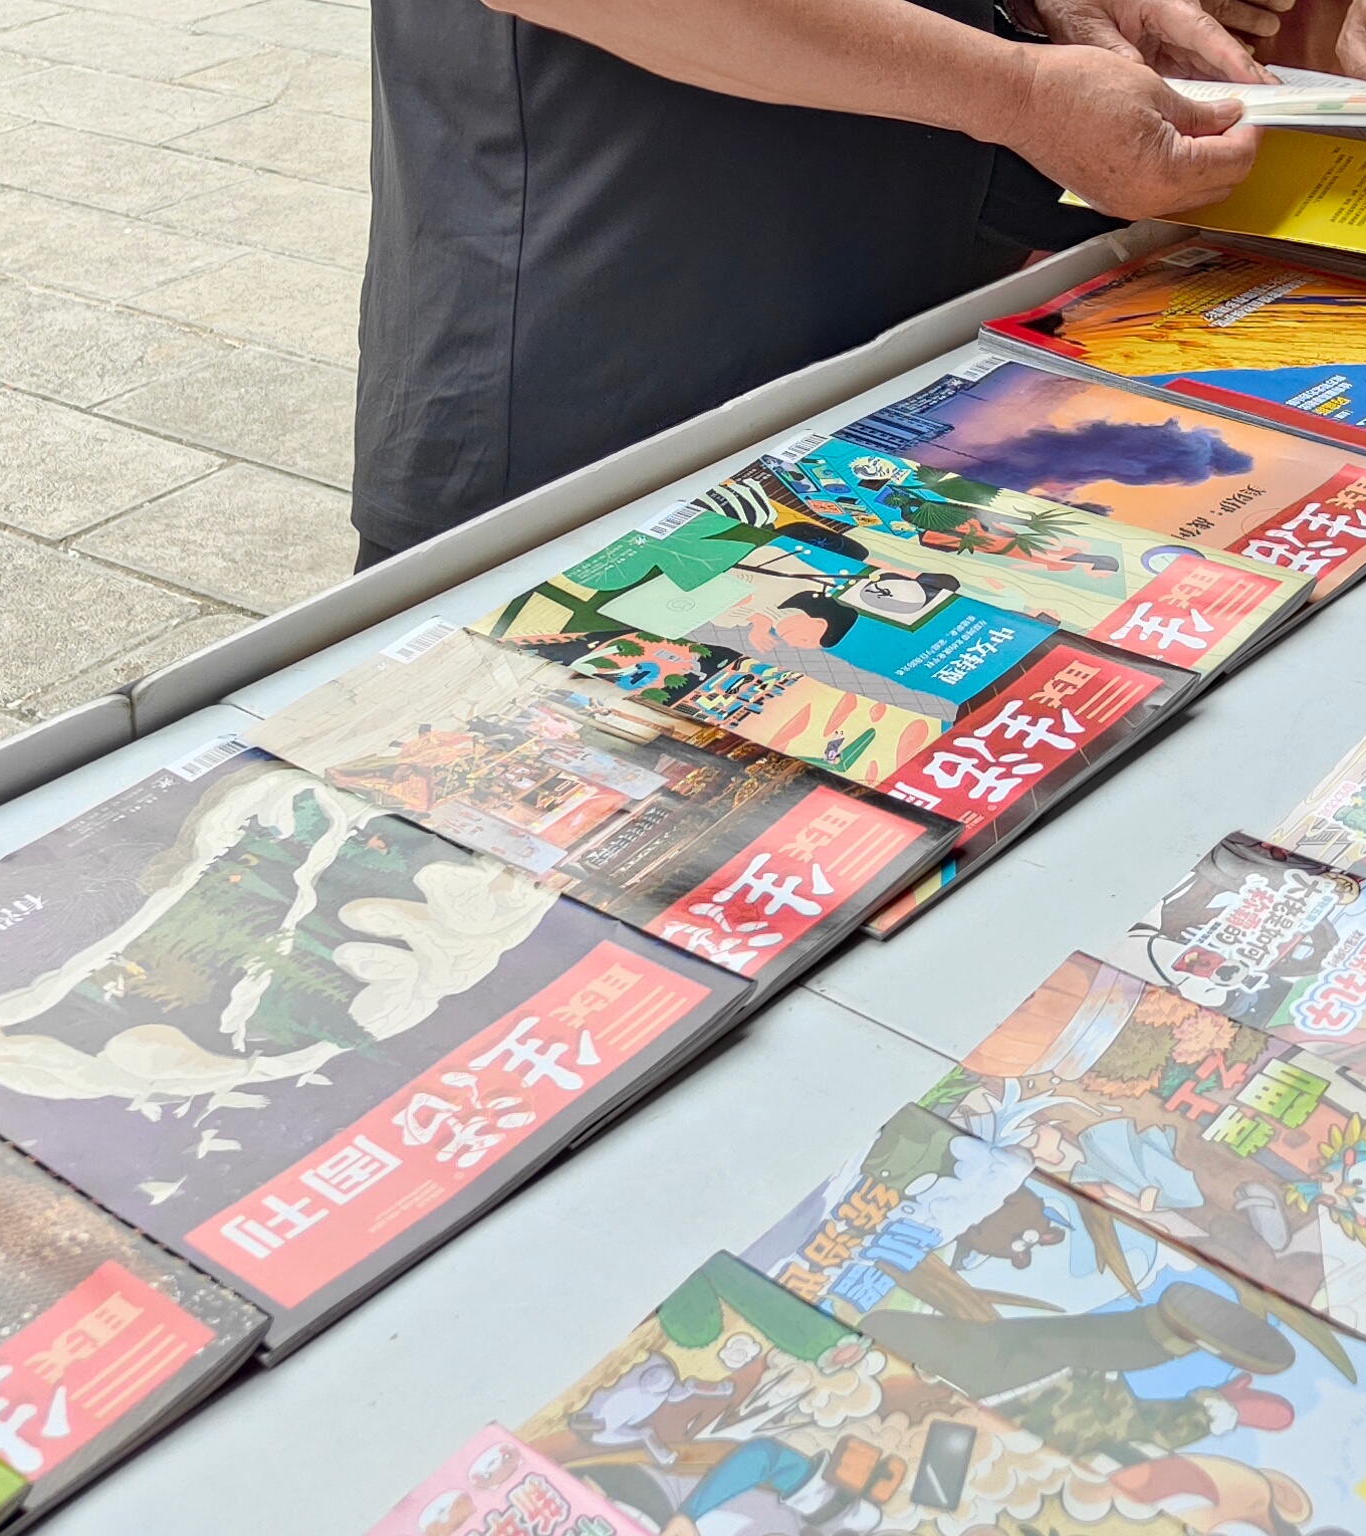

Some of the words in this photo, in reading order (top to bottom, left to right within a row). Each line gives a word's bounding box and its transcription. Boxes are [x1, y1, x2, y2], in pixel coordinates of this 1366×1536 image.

[933, 624, 1015, 687] 中女转型
[1161, 1052, 1253, 1122] 之上
[220, 1015, 600, 1262] 生活周刊
